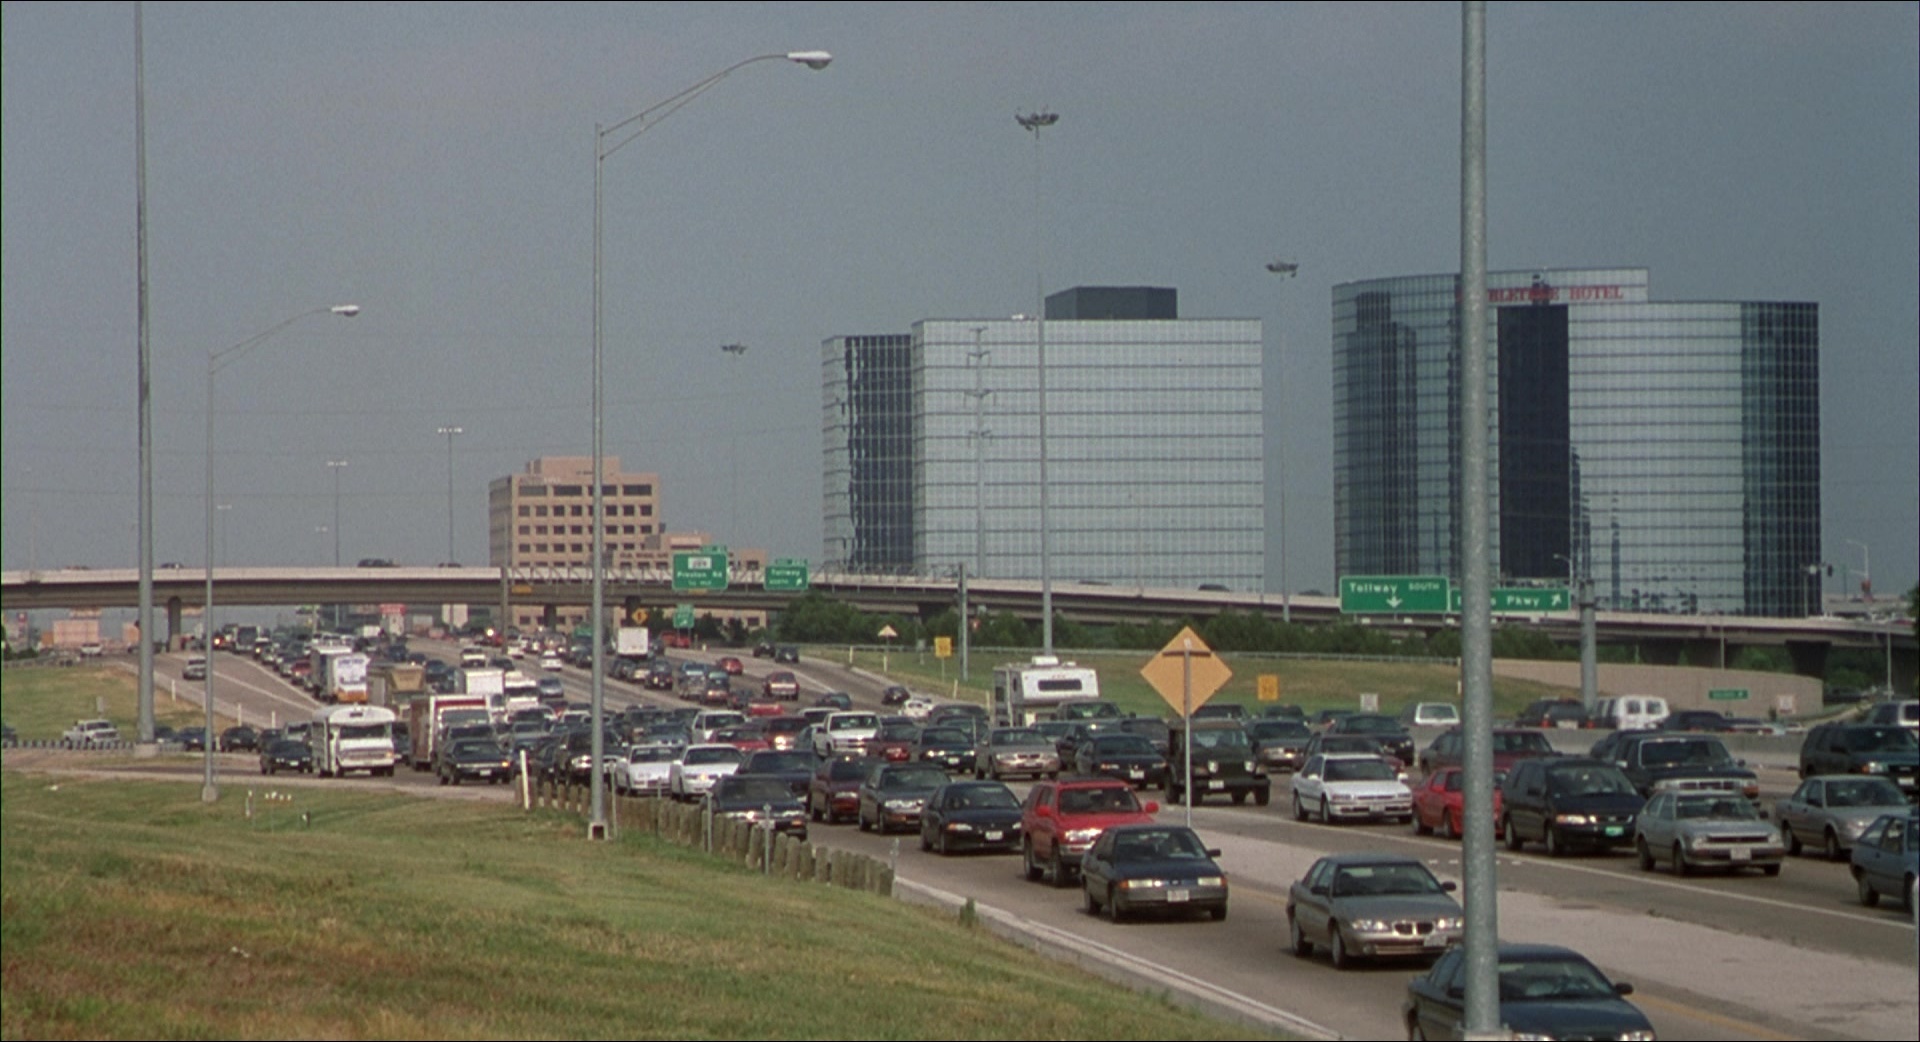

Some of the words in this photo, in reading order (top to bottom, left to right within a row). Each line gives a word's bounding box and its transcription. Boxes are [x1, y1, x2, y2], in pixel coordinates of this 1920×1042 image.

[1569, 285, 1624, 301] HOTEL
[1349, 582, 1398, 594] Tollway
[1408, 582, 1440, 591] SOUTH
[1506, 595, 1540, 607] Pkwy
